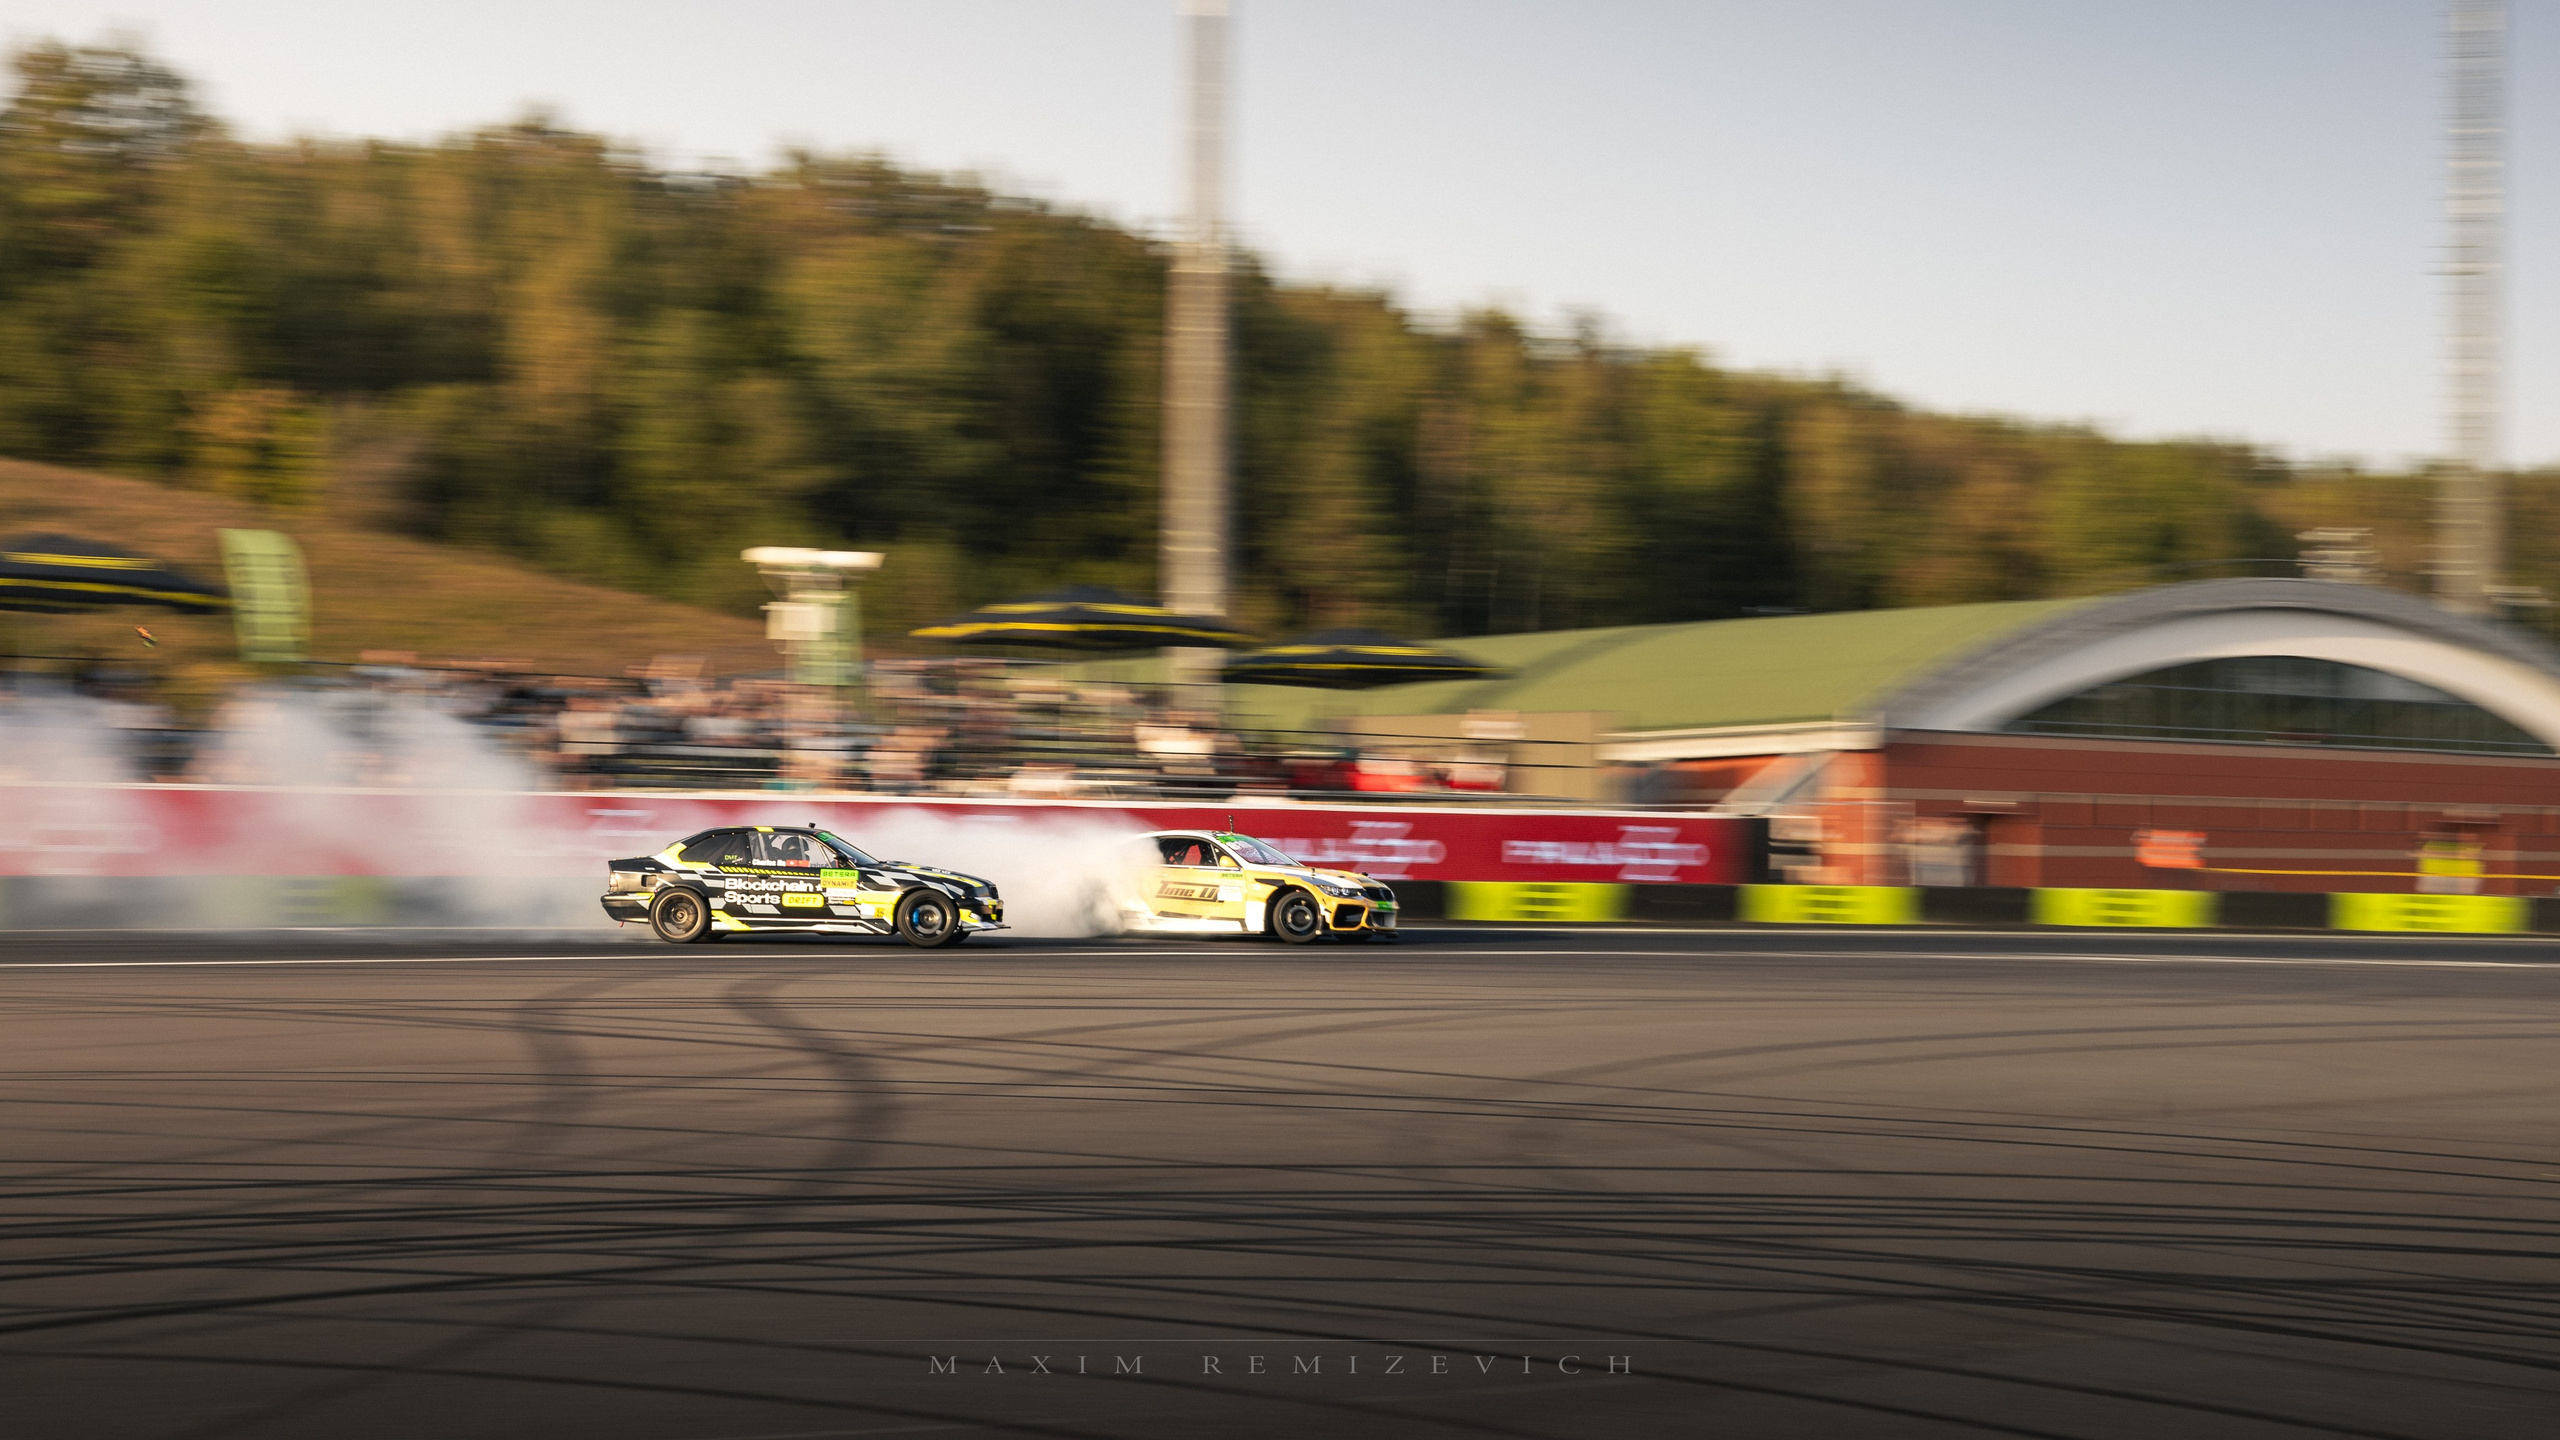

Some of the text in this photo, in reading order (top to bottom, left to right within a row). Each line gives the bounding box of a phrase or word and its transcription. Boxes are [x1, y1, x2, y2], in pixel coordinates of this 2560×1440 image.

[725, 878, 814, 892] Blockchain
[1156, 880, 1196, 898] Time
[724, 891, 780, 905] Sports
[788, 896, 818, 904] DRIFT
